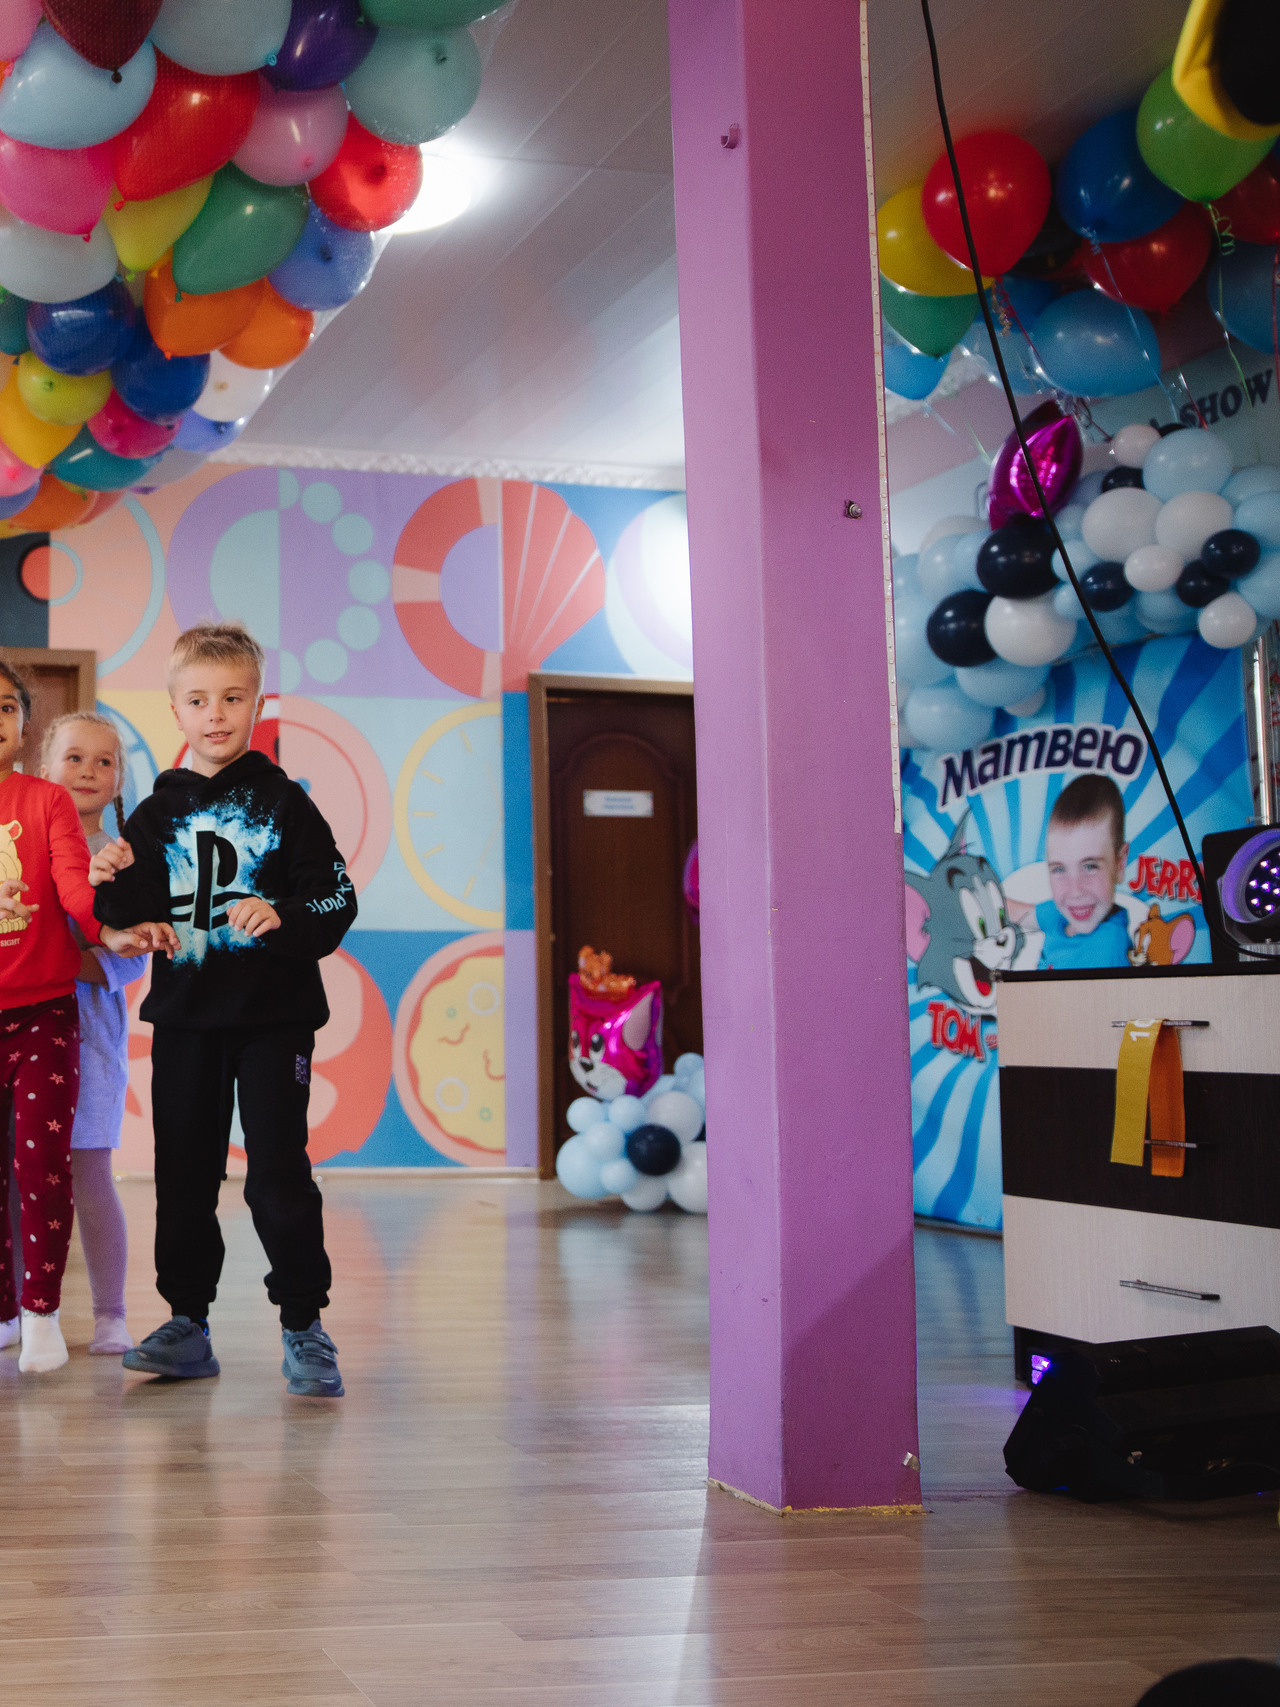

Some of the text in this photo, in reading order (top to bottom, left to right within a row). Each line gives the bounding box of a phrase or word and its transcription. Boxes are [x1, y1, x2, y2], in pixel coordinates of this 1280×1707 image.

[1180, 368, 1273, 428] SHOW
[1129, 855, 1206, 904] JERR
[0, 938, 20, 947] SIGHT
[927, 1002, 986, 1062] TOM
